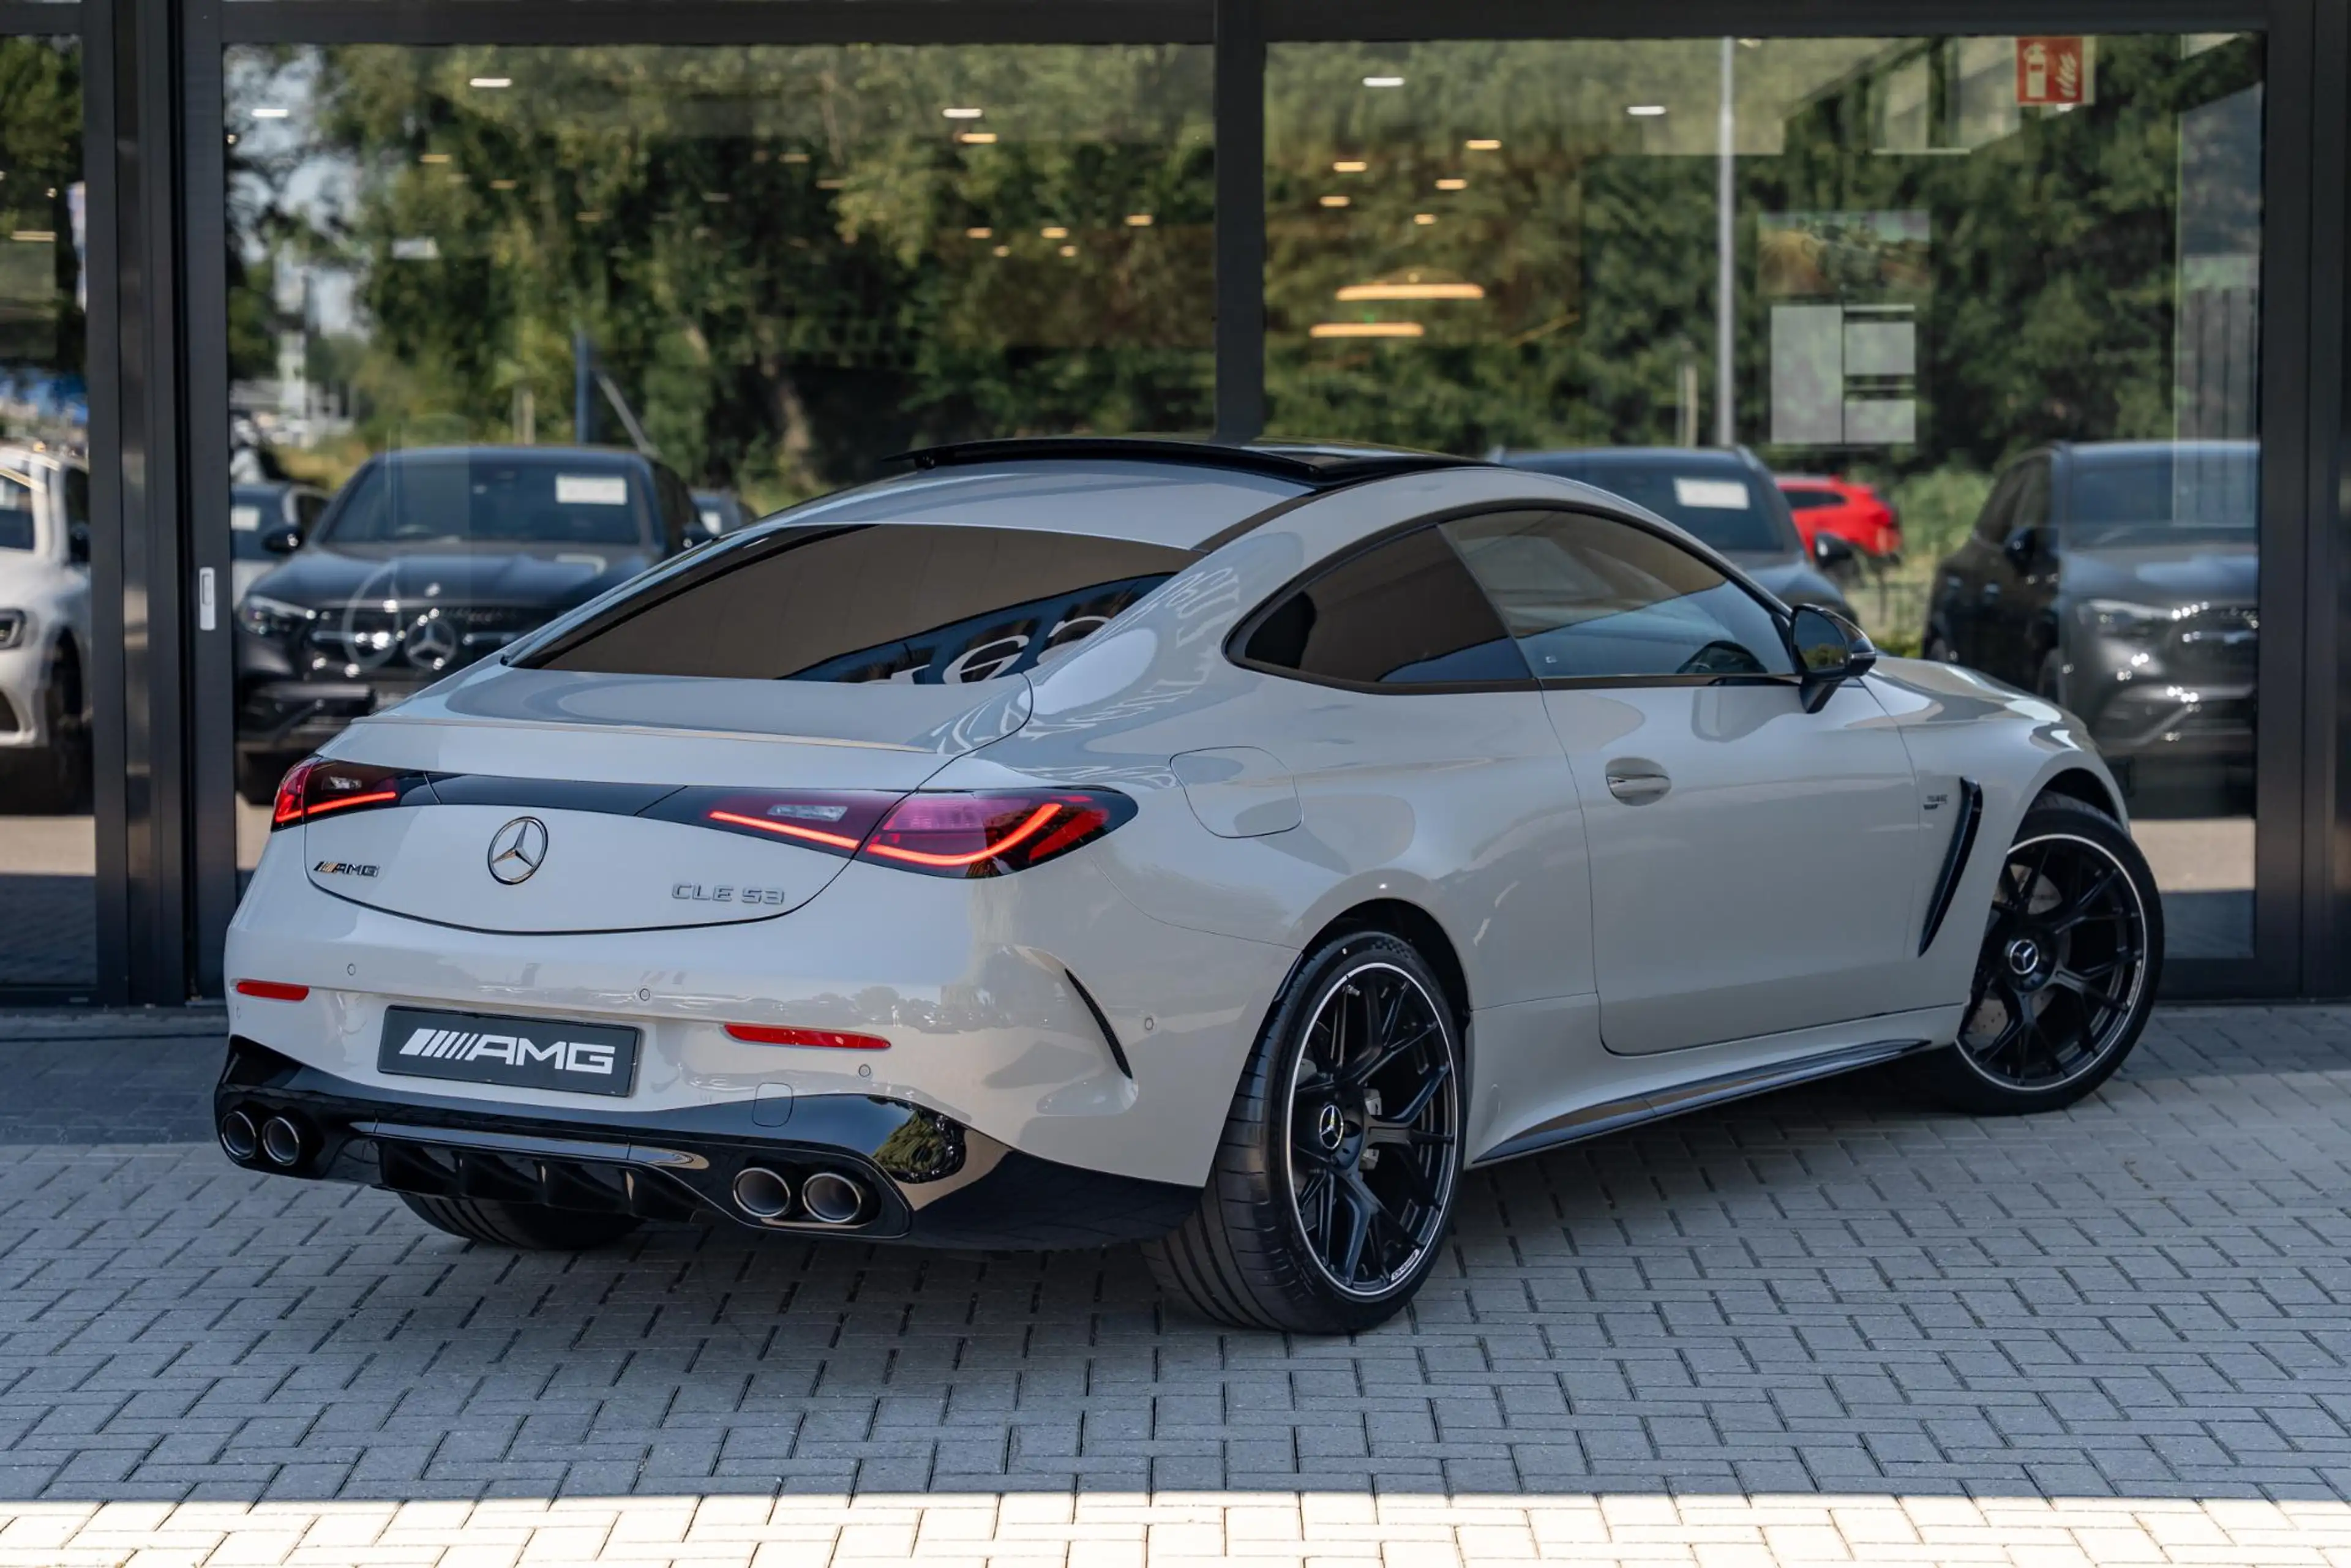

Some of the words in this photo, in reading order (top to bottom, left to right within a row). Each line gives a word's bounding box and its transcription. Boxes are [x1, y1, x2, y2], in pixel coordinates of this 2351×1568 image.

[331, 863, 380, 877] AMG
[672, 885, 734, 902] CLE
[741, 887, 784, 904] 53
[464, 1033, 616, 1075] AMG
